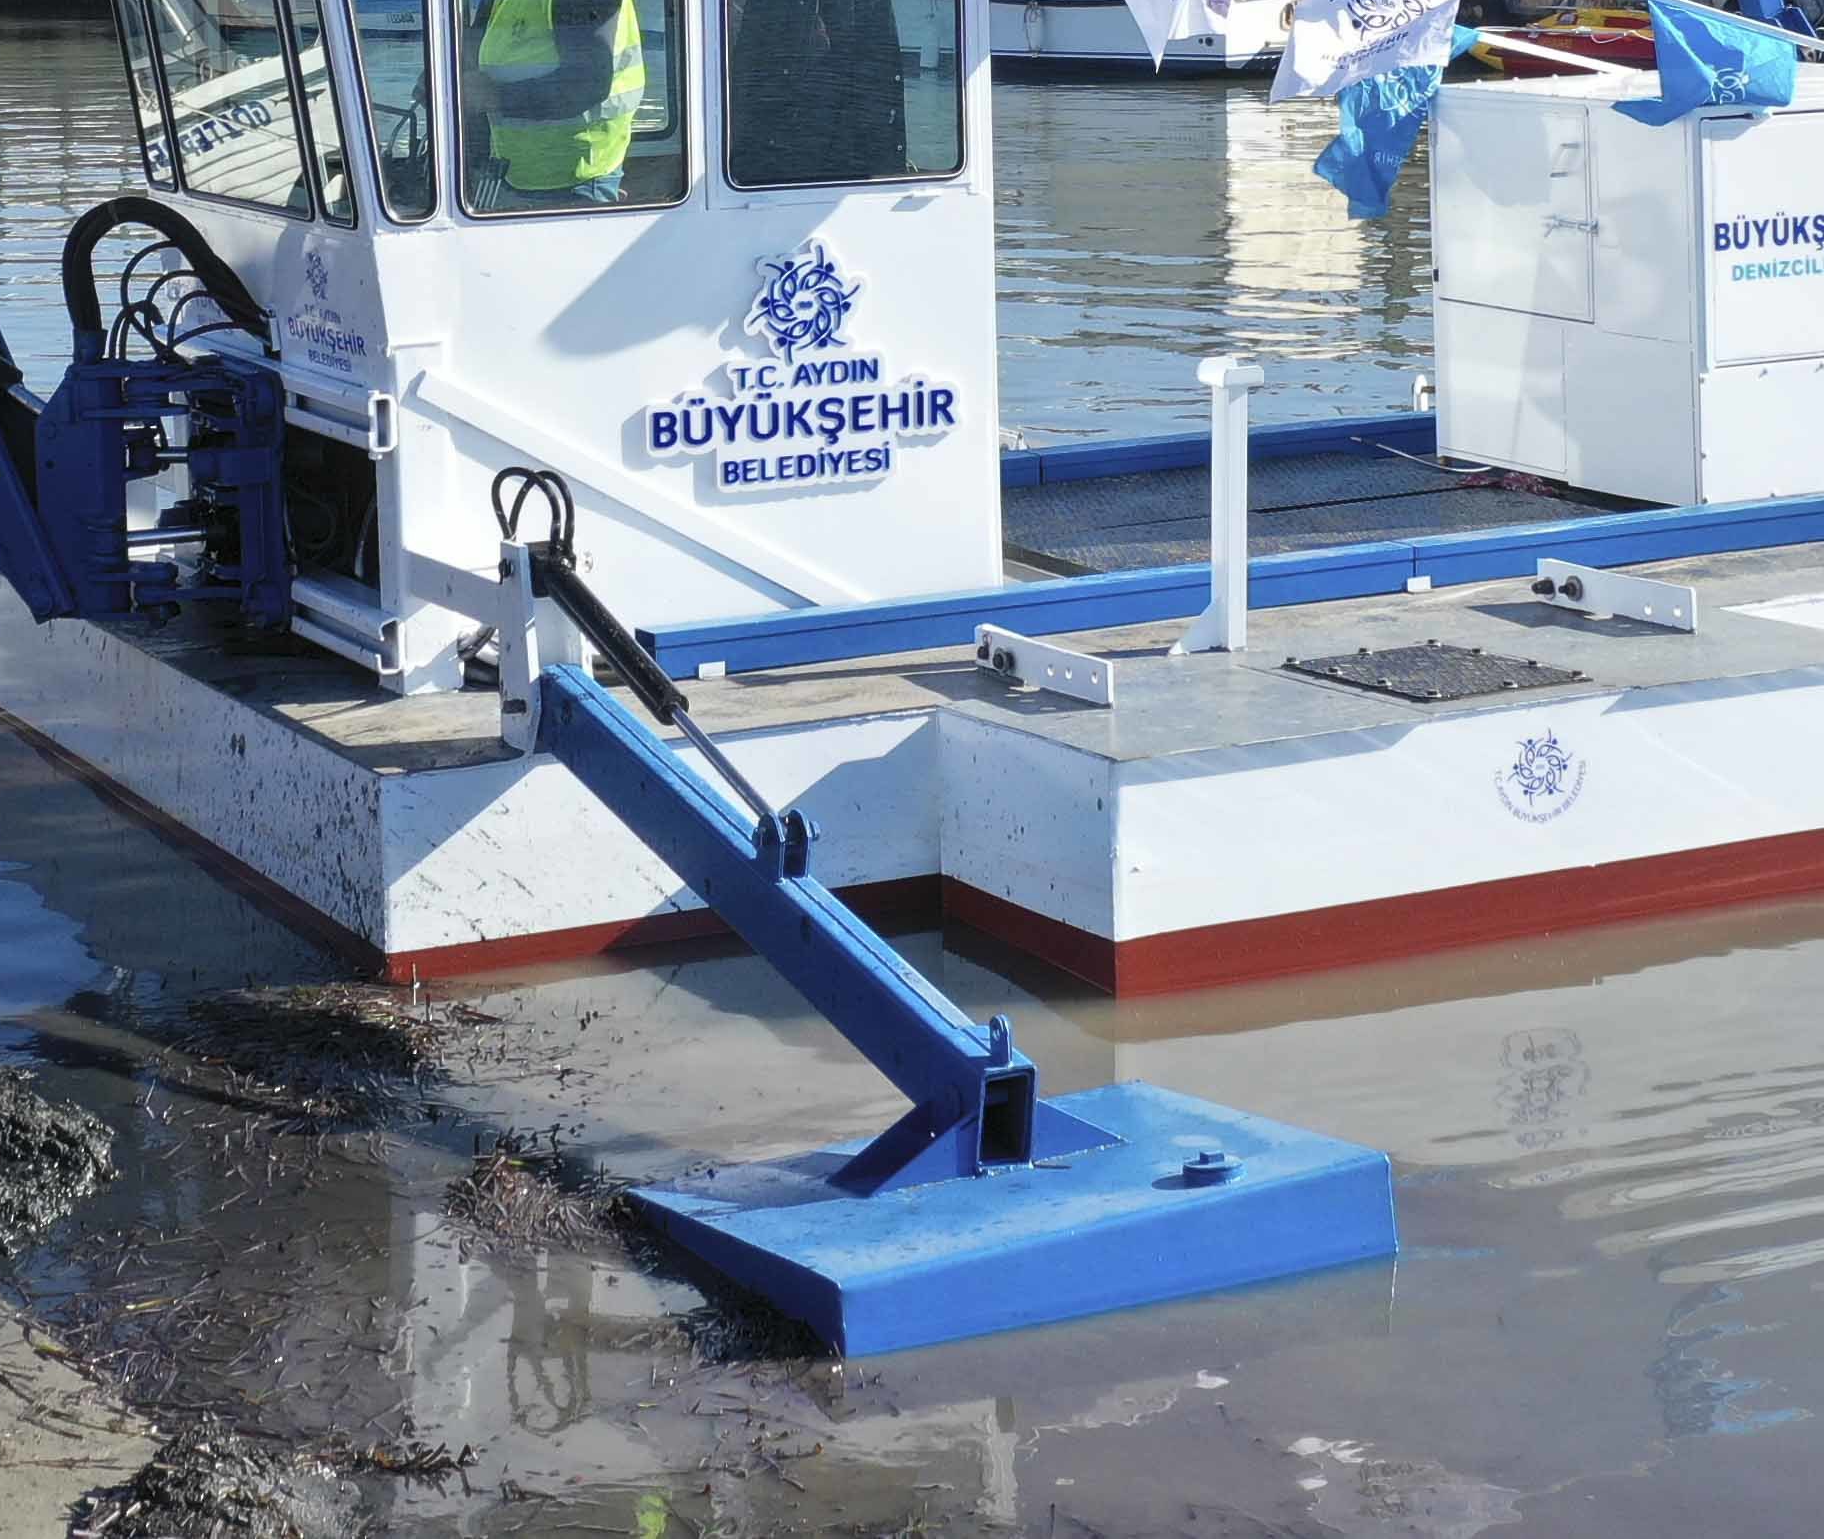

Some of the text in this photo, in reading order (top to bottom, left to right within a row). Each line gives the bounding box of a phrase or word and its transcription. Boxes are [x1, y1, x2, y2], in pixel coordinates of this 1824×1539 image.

[287, 316, 367, 357] BÜYÜKŞEHİR
[733, 357, 880, 391] T.C. AYDIN
[651, 380, 956, 449] BÜYÜKŞEHİR
[723, 442, 892, 485] BELEDİYESİ
